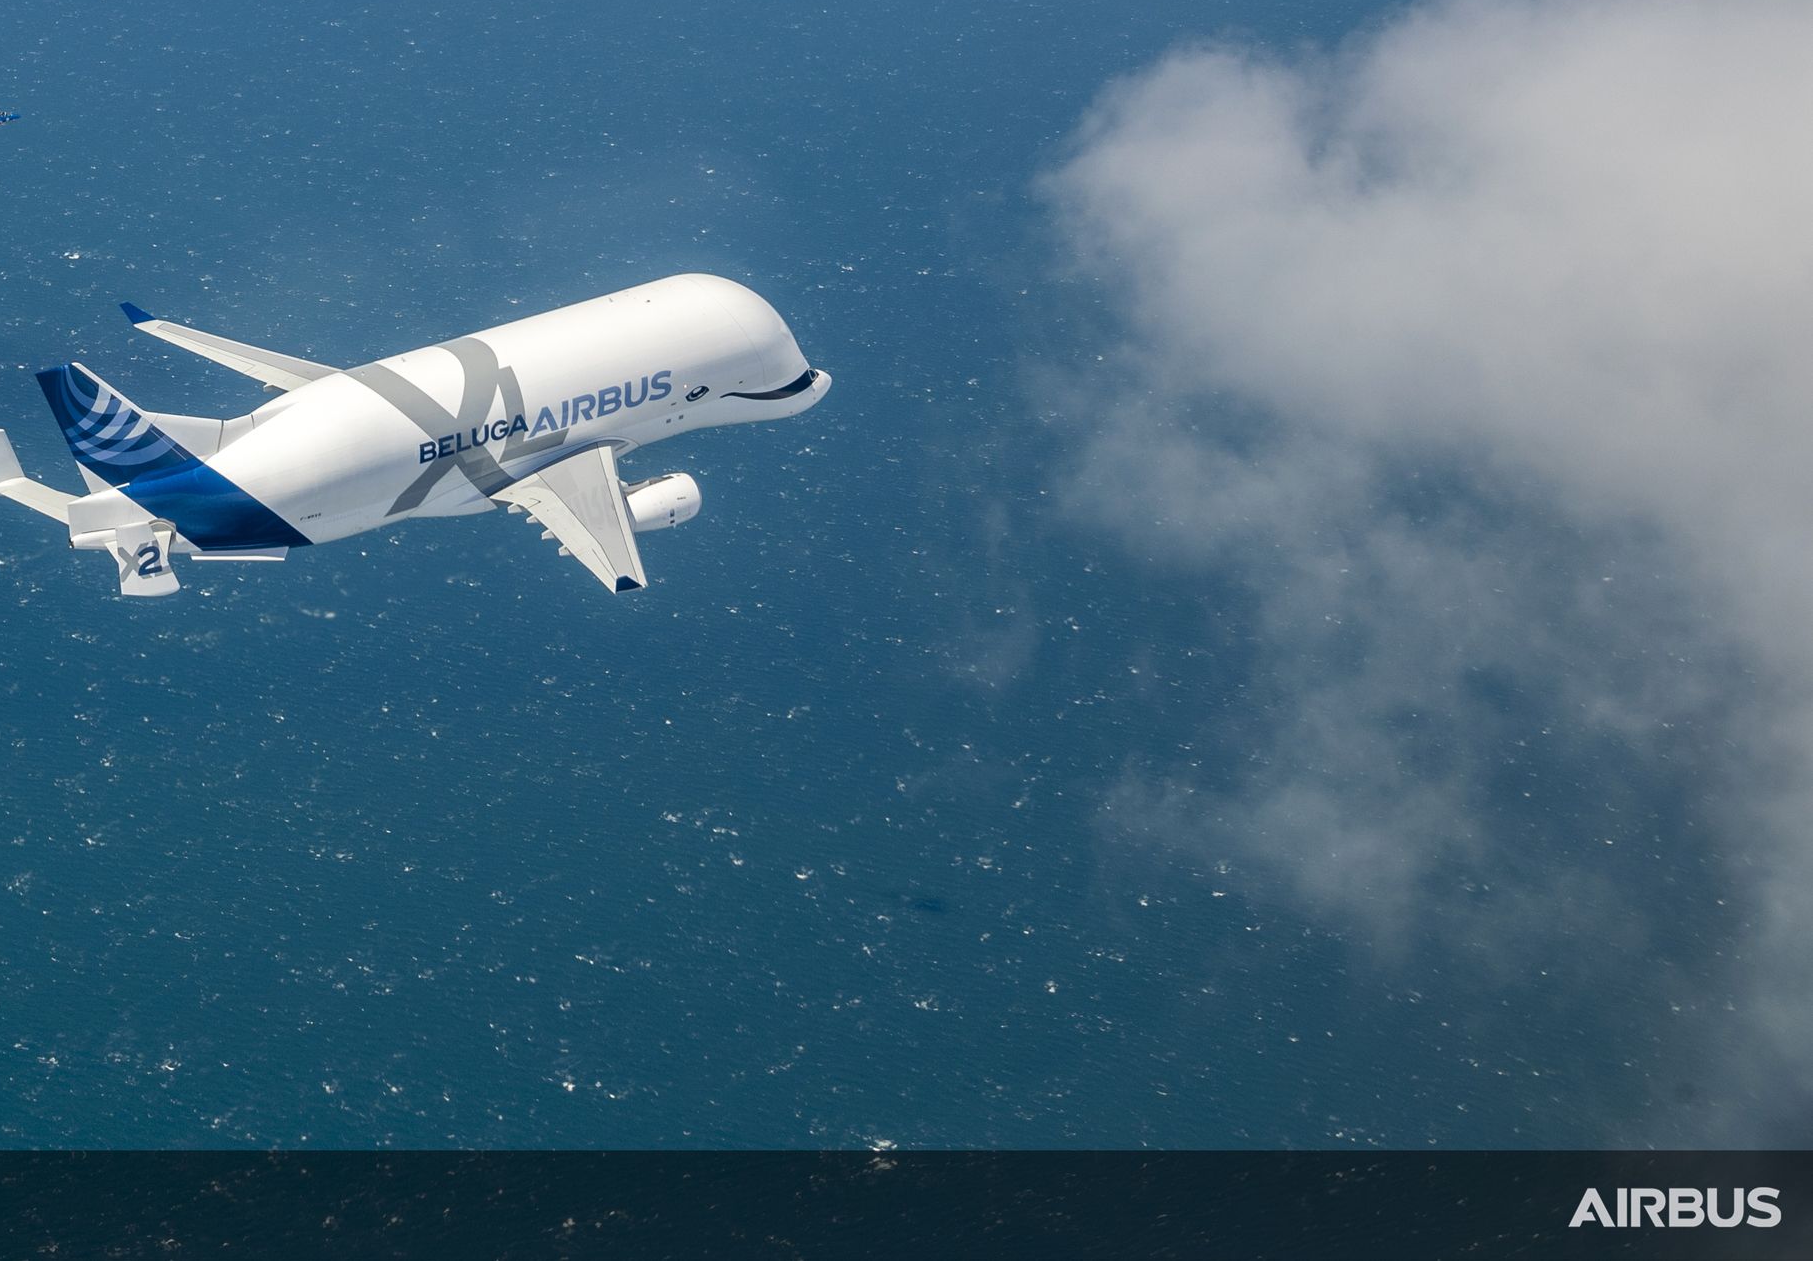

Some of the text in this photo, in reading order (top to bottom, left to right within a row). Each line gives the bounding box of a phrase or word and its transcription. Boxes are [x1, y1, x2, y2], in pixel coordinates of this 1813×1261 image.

[419, 370, 672, 464] BELUGA AIRBUS
[138, 546, 163, 577] 2
